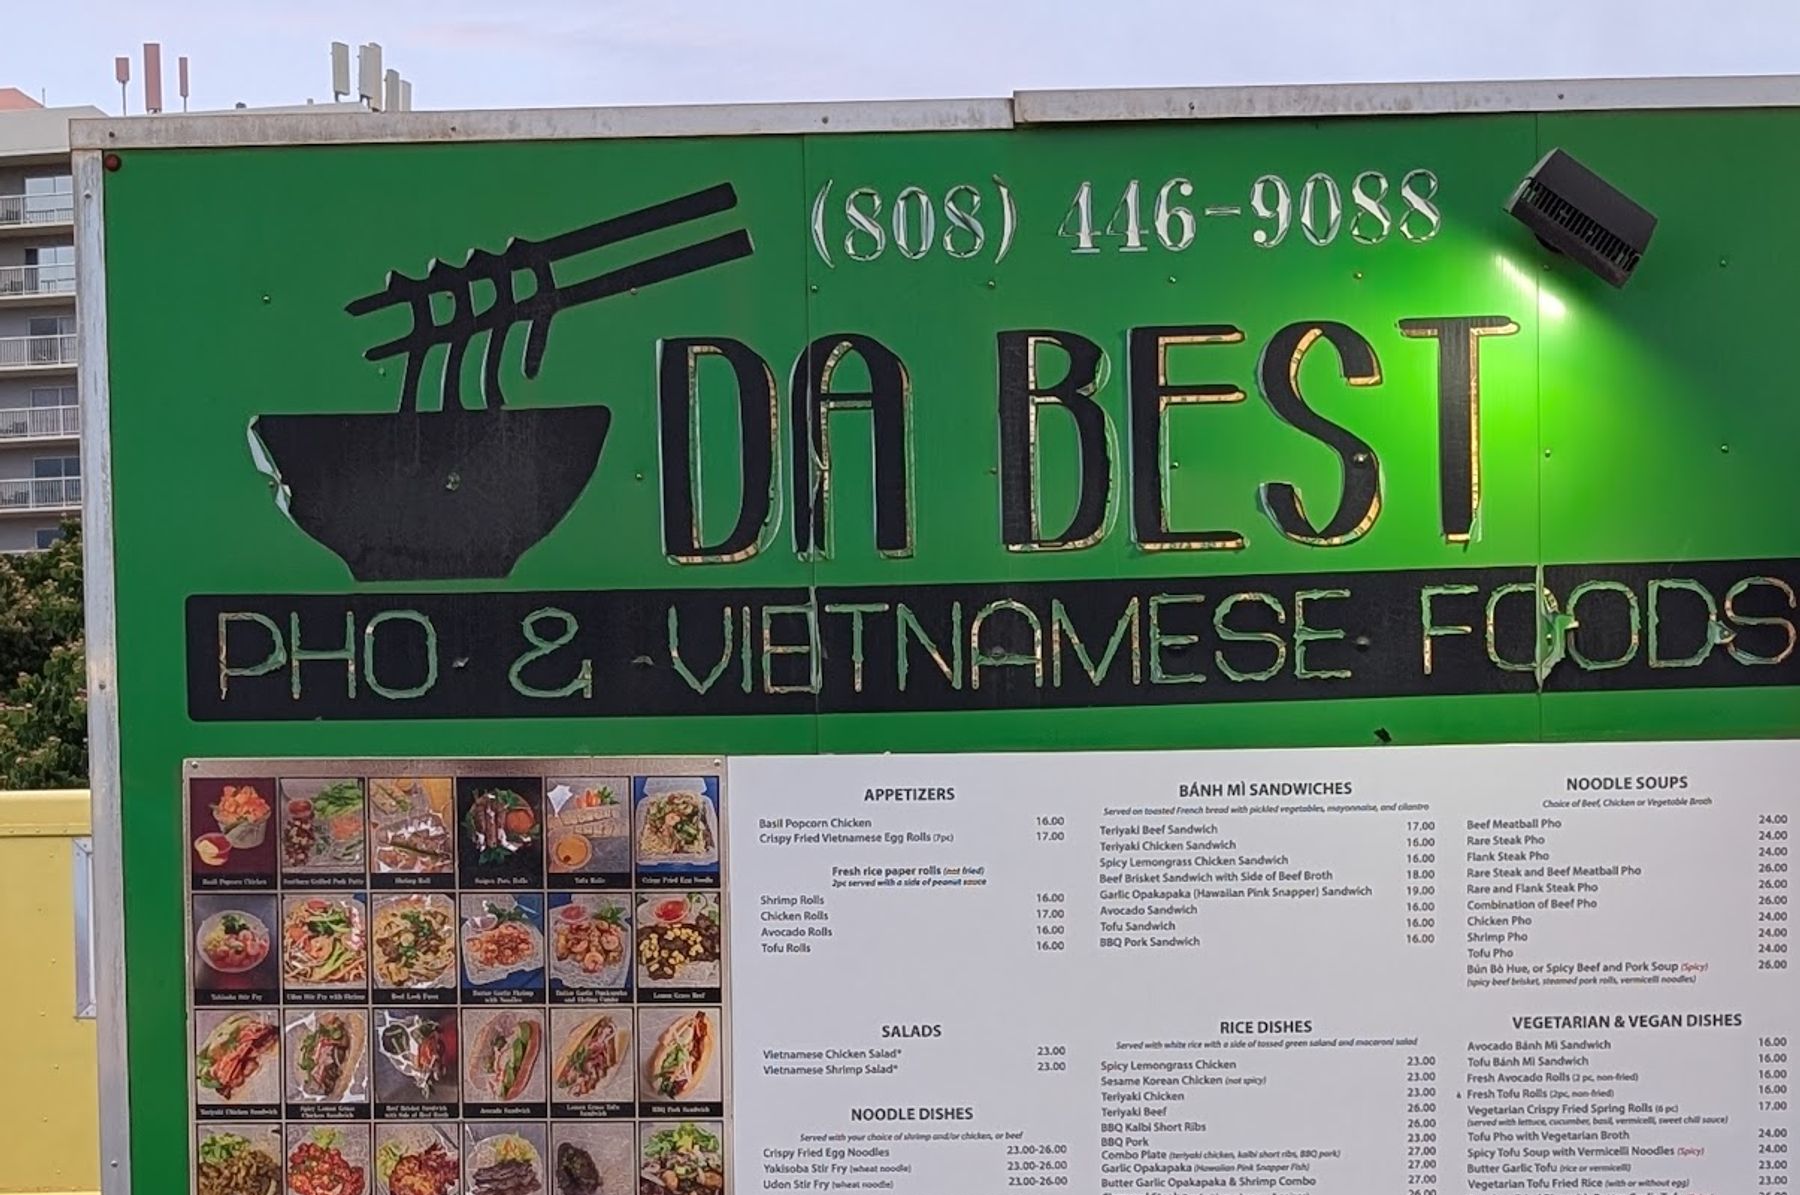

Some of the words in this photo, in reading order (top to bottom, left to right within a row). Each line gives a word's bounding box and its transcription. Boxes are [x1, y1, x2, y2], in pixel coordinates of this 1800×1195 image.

[810, 173, 1018, 268] (808)
[1056, 168, 1443, 254] 446-9088
[655, 333, 917, 566] DA
[996, 316, 1525, 554] BEST
[217, 608, 439, 701] PHO
[507, 606, 594, 700] &
[666, 588, 1353, 695] VIETNAMESE
[1420, 575, 1798, 678] FOODS
[1179, 781, 1223, 797] BÁNH
[1227, 780, 1246, 796] MÌ
[1249, 781, 1353, 796] SANDWICHES
[1566, 777, 1633, 791] NOODLE
[1636, 775, 1688, 790] SOUPS
[864, 787, 956, 802] APPETIZERS
[759, 818, 784, 829] Basil
[785, 818, 829, 830] Popcorn
[830, 817, 872, 828] Chicken
[1036, 816, 1065, 826] 16.00
[1467, 819, 1491, 830] Beef
[1492, 818, 1539, 829] Meatball
[1541, 818, 1562, 829] Pho
[1758, 814, 1788, 825] 24.00
[759, 833, 792, 846] Crispy
[793, 833, 820, 843] Fried
[821, 832, 883, 843] Vietnamese
[884, 832, 904, 845] Egg
[906, 831, 932, 842] Rolls
[1036, 831, 1065, 841] 17.00
[1406, 837, 1436, 847] 16.00
[1099, 840, 1141, 854] Teriyaki
[1142, 840, 1184, 851] Chicken
[1186, 839, 1237, 850] Sandwich
[1099, 873, 1123, 884] Beef
[1125, 873, 1161, 884] Brisket
[1162, 872, 1213, 883] Sandwich
[1215, 871, 1239, 882] with
[1240, 871, 1264, 882] Side
[1265, 871, 1277, 881] of
[1278, 870, 1303, 881] Beef
[1304, 870, 1333, 881] Broth
[1407, 869, 1436, 880] 18.00
[760, 895, 798, 907] Shrimp
[800, 895, 825, 905] Rolls
[1036, 893, 1065, 903] 16.00
[1467, 899, 1536, 910] Combination
[1537, 898, 1549, 909] of
[1550, 898, 1575, 909] Beef
[1576, 898, 1598, 909] Pho
[1758, 895, 1788, 905] 26.00
[1100, 921, 1124, 932] Tofu
[1125, 920, 1176, 932] Sandwich
[1406, 918, 1435, 928] 16.00
[761, 926, 807, 937] Avocado
[808, 926, 833, 937] Rolls
[1036, 925, 1065, 935] 16.00
[1467, 948, 1491, 959] Tofu
[1493, 948, 1514, 958] Pho
[1758, 943, 1788, 953] 24.00
[1220, 1021, 1254, 1034] RICE
[1257, 1020, 1313, 1034] DISHES
[1512, 1015, 1610, 1029] VEGETARIAN
[1614, 1015, 1625, 1028] &
[1628, 1014, 1682, 1028] VEGAN
[1686, 1013, 1742, 1027] DISHES
[882, 1024, 942, 1038] SALADS
[763, 1049, 824, 1060] Vietnamese
[825, 1049, 867, 1059] Chicken
[1037, 1046, 1066, 1056] 23.00
[1100, 1060, 1129, 1072] Spicy
[1130, 1060, 1193, 1072] Lemongrass
[1195, 1059, 1237, 1070] Chicken
[1407, 1056, 1436, 1066] 23.00
[851, 1108, 916, 1121] NOODLE
[919, 1107, 974, 1121] DISHES
[1100, 1122, 1124, 1134] BBQ
[1125, 1122, 1152, 1132] Kalbi
[1153, 1122, 1182, 1132] Short
[1184, 1121, 1207, 1132] Ribs
[1407, 1118, 1437, 1128] 26.00
[1467, 1131, 1491, 1142] Tofu
[1493, 1131, 1514, 1142] Pho
[1515, 1131, 1540, 1141] with
[1541, 1130, 1599, 1142] Vegetarian
[1600, 1129, 1630, 1140] Broth
[1758, 1128, 1788, 1138] 24.00
[763, 1148, 795, 1160] Crispy
[797, 1147, 823, 1158] Fried
[825, 1147, 846, 1160] Egg
[847, 1147, 890, 1157] Noodles
[1006, 1144, 1068, 1155] 23.00-26.00
